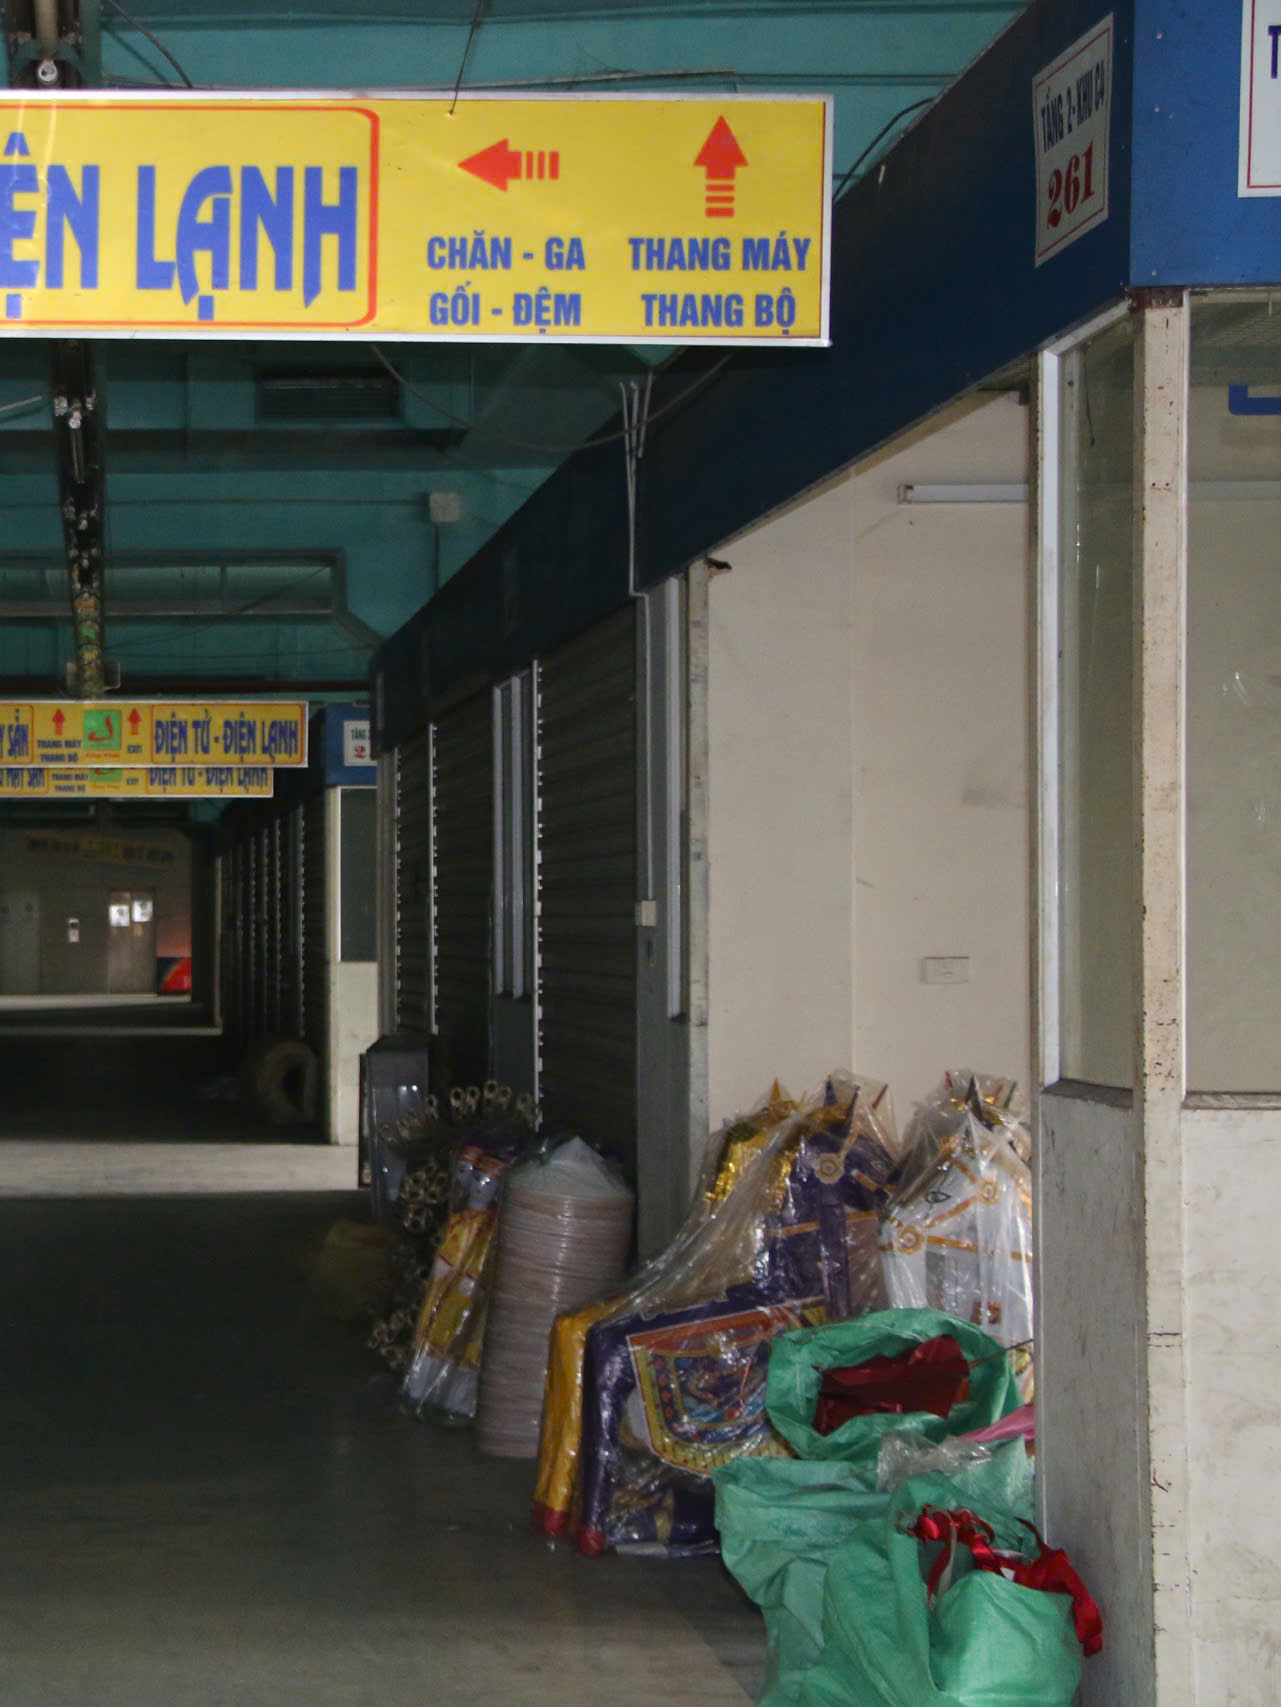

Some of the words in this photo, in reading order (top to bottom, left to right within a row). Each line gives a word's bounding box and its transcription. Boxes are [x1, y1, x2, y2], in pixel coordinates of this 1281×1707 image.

[1047, 138, 1095, 230] 261
[135, 164, 358, 321] LẠNH
[426, 229, 512, 272] CHĂN
[544, 236, 586, 272] GA
[629, 236, 731, 272] THANG
[742, 227, 812, 272] MÁY
[428, 281, 481, 329] GỐI
[513, 284, 582, 335] ĐỆM
[641, 293, 742, 329] THANG
[754, 284, 796, 335] BỘ
[154, 712, 188, 763] ĐIỆN
[192, 708, 212, 755] TỬ
[223, 712, 257, 763] ĐIỆN
[261, 719, 299, 764] LẠNH
